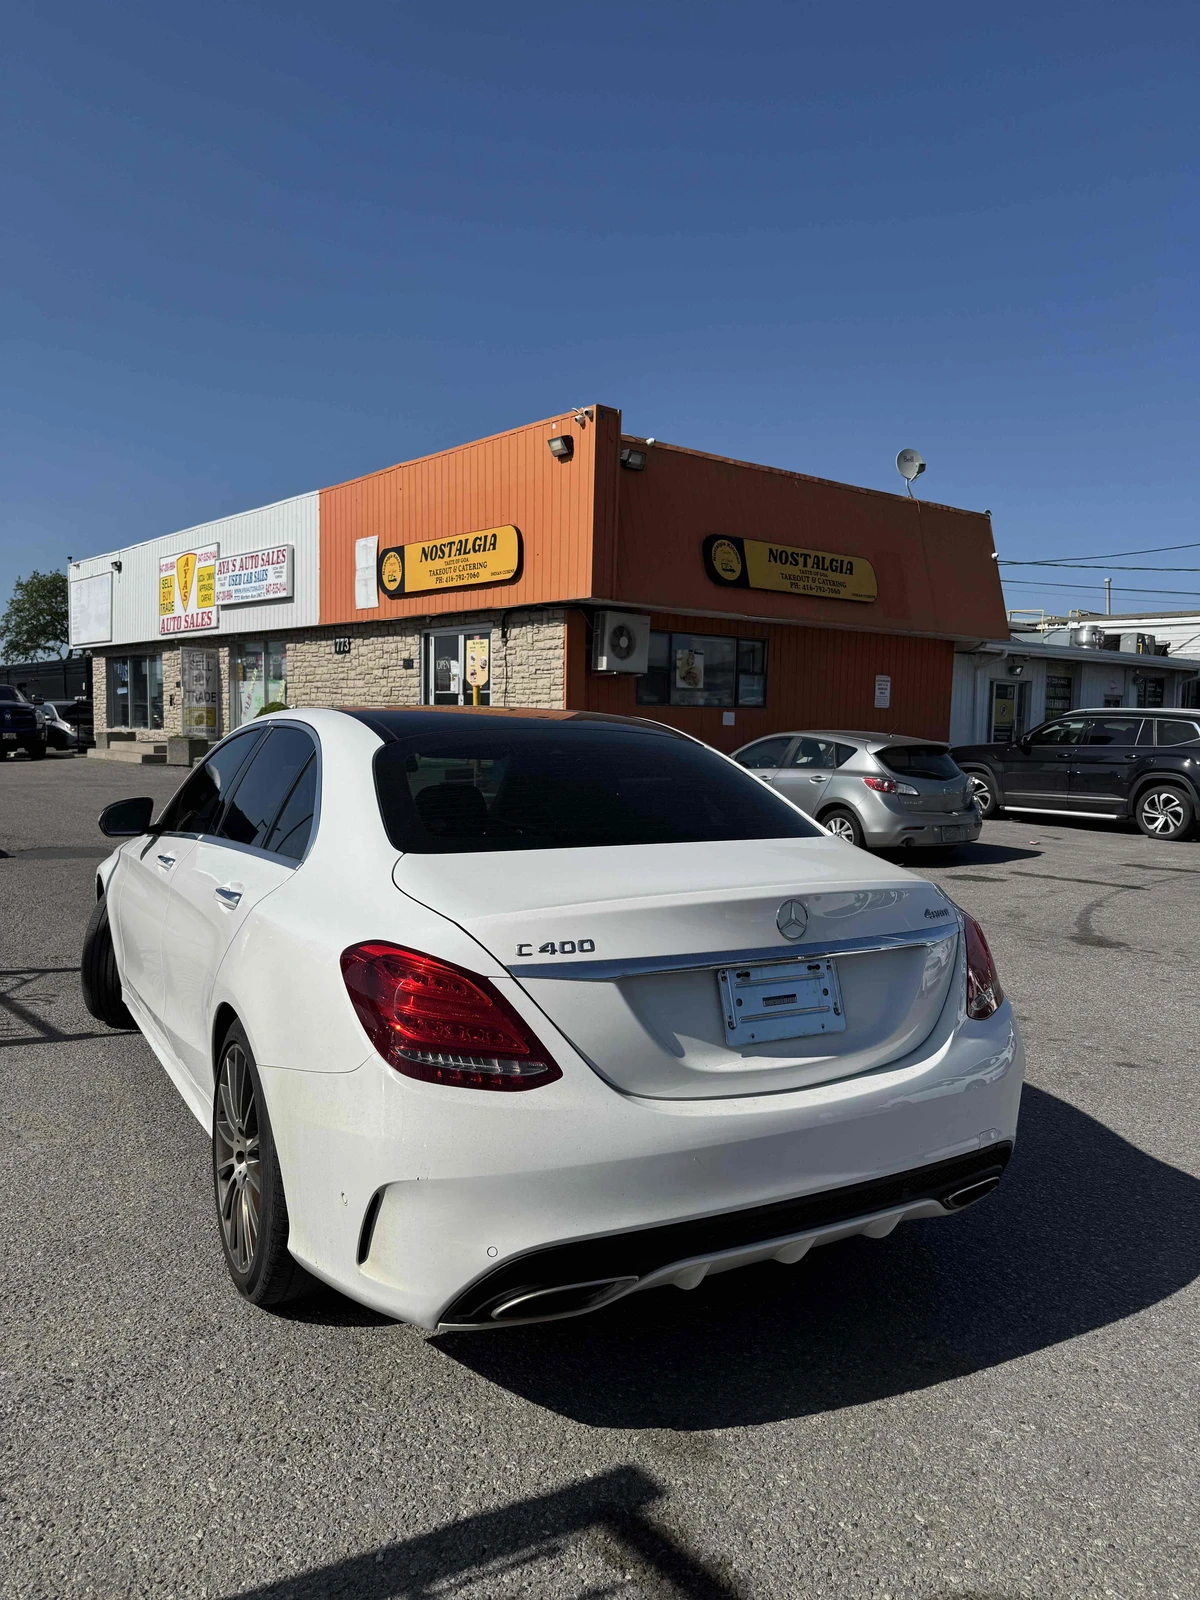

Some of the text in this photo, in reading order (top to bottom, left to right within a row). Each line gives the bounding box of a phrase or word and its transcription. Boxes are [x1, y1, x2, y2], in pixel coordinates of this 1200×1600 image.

[420, 533, 498, 563] NOSTALGIA
[217, 549, 286, 576] AYA'S AUTO SALES
[767, 547, 854, 575] NOSTALGIA
[429, 566, 452, 577] TAKEOUT
[458, 562, 488, 573] CATERING
[162, 578, 172, 590] SELL
[228, 569, 268, 586] USED CAR SALES
[445, 572, 480, 584] 416-792-7060
[780, 573, 810, 583] TAKEOUT
[817, 577, 847, 588] CATERING
[162, 590, 172, 602] BUY
[802, 584, 841, 595] 416-792-7060
[160, 601, 174, 613] TRADE
[160, 610, 213, 632] AUTO SALES
[336, 638, 349, 652] 773
[190, 659, 213, 671] SELL
[436, 660, 450, 670] OPEN
[192, 675, 211, 687] BUY
[186, 690, 216, 704] TRADE
[516, 939, 595, 957] C 400
